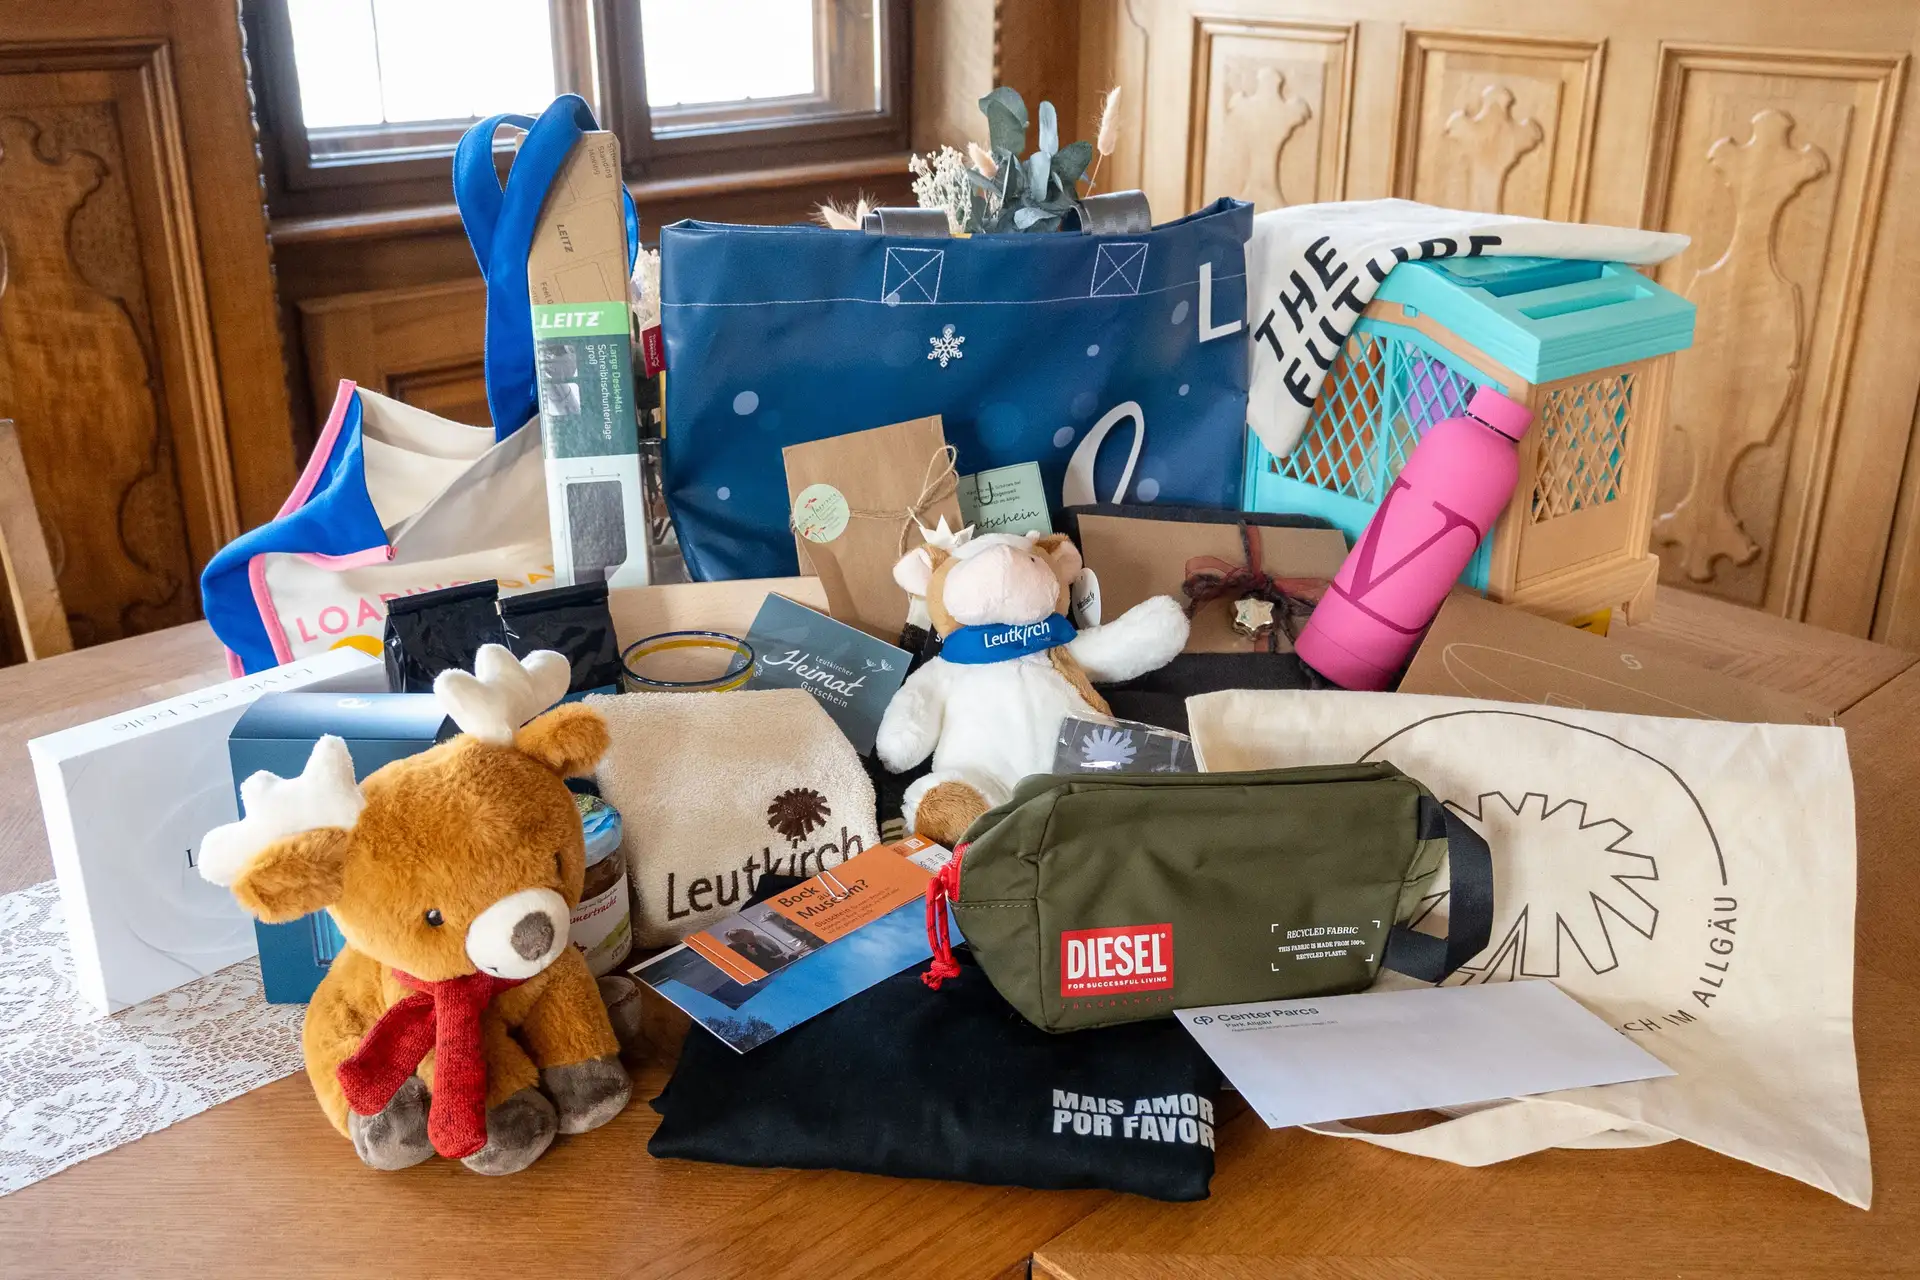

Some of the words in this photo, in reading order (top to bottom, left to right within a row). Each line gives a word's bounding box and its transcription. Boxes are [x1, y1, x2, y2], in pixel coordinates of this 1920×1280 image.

[600, 145, 613, 179] Standing
[556, 224, 573, 253] LEITZ
[1254, 236, 1348, 362] THE
[539, 310, 600, 329] LEITZ
[585, 344, 598, 365] groß
[610, 343, 618, 370] Large
[597, 343, 613, 440] Schreibtischunterlage
[984, 621, 1050, 649] Leutkirch
[762, 650, 867, 697] Heimat
[815, 655, 854, 677] Leutkircher
[801, 681, 849, 708] Gutschein
[112, 709, 178, 732] belle
[667, 826, 864, 922] Leutkirch
[777, 884, 820, 908] Bock
[796, 879, 869, 920] Museum?
[1286, 927, 1325, 939] RECYCLED
[1326, 926, 1359, 935] FABRIC
[1067, 933, 1167, 980] DIESEL
[1278, 945, 1291, 953] THIS
[1291, 943, 1310, 951] FABRIC
[1317, 941, 1333, 949] MADE
[1295, 951, 1324, 961] RECYCLED
[1324, 949, 1348, 958] PLASTIC
[1661, 1009, 1698, 1027] IM
[1692, 897, 1737, 1008] ALLGÄU
[1068, 983, 1085, 991] FOR
[1087, 979, 1140, 989] SUCCESSFUL
[1141, 976, 1167, 984] LIVING
[1247, 1019, 1273, 1027] Allgäu
[1053, 1088, 1124, 1115] MAIS
[1134, 1093, 1215, 1126] AMOR
[1052, 1109, 1112, 1137] POR
[1123, 1115, 1216, 1152] FAVOR
